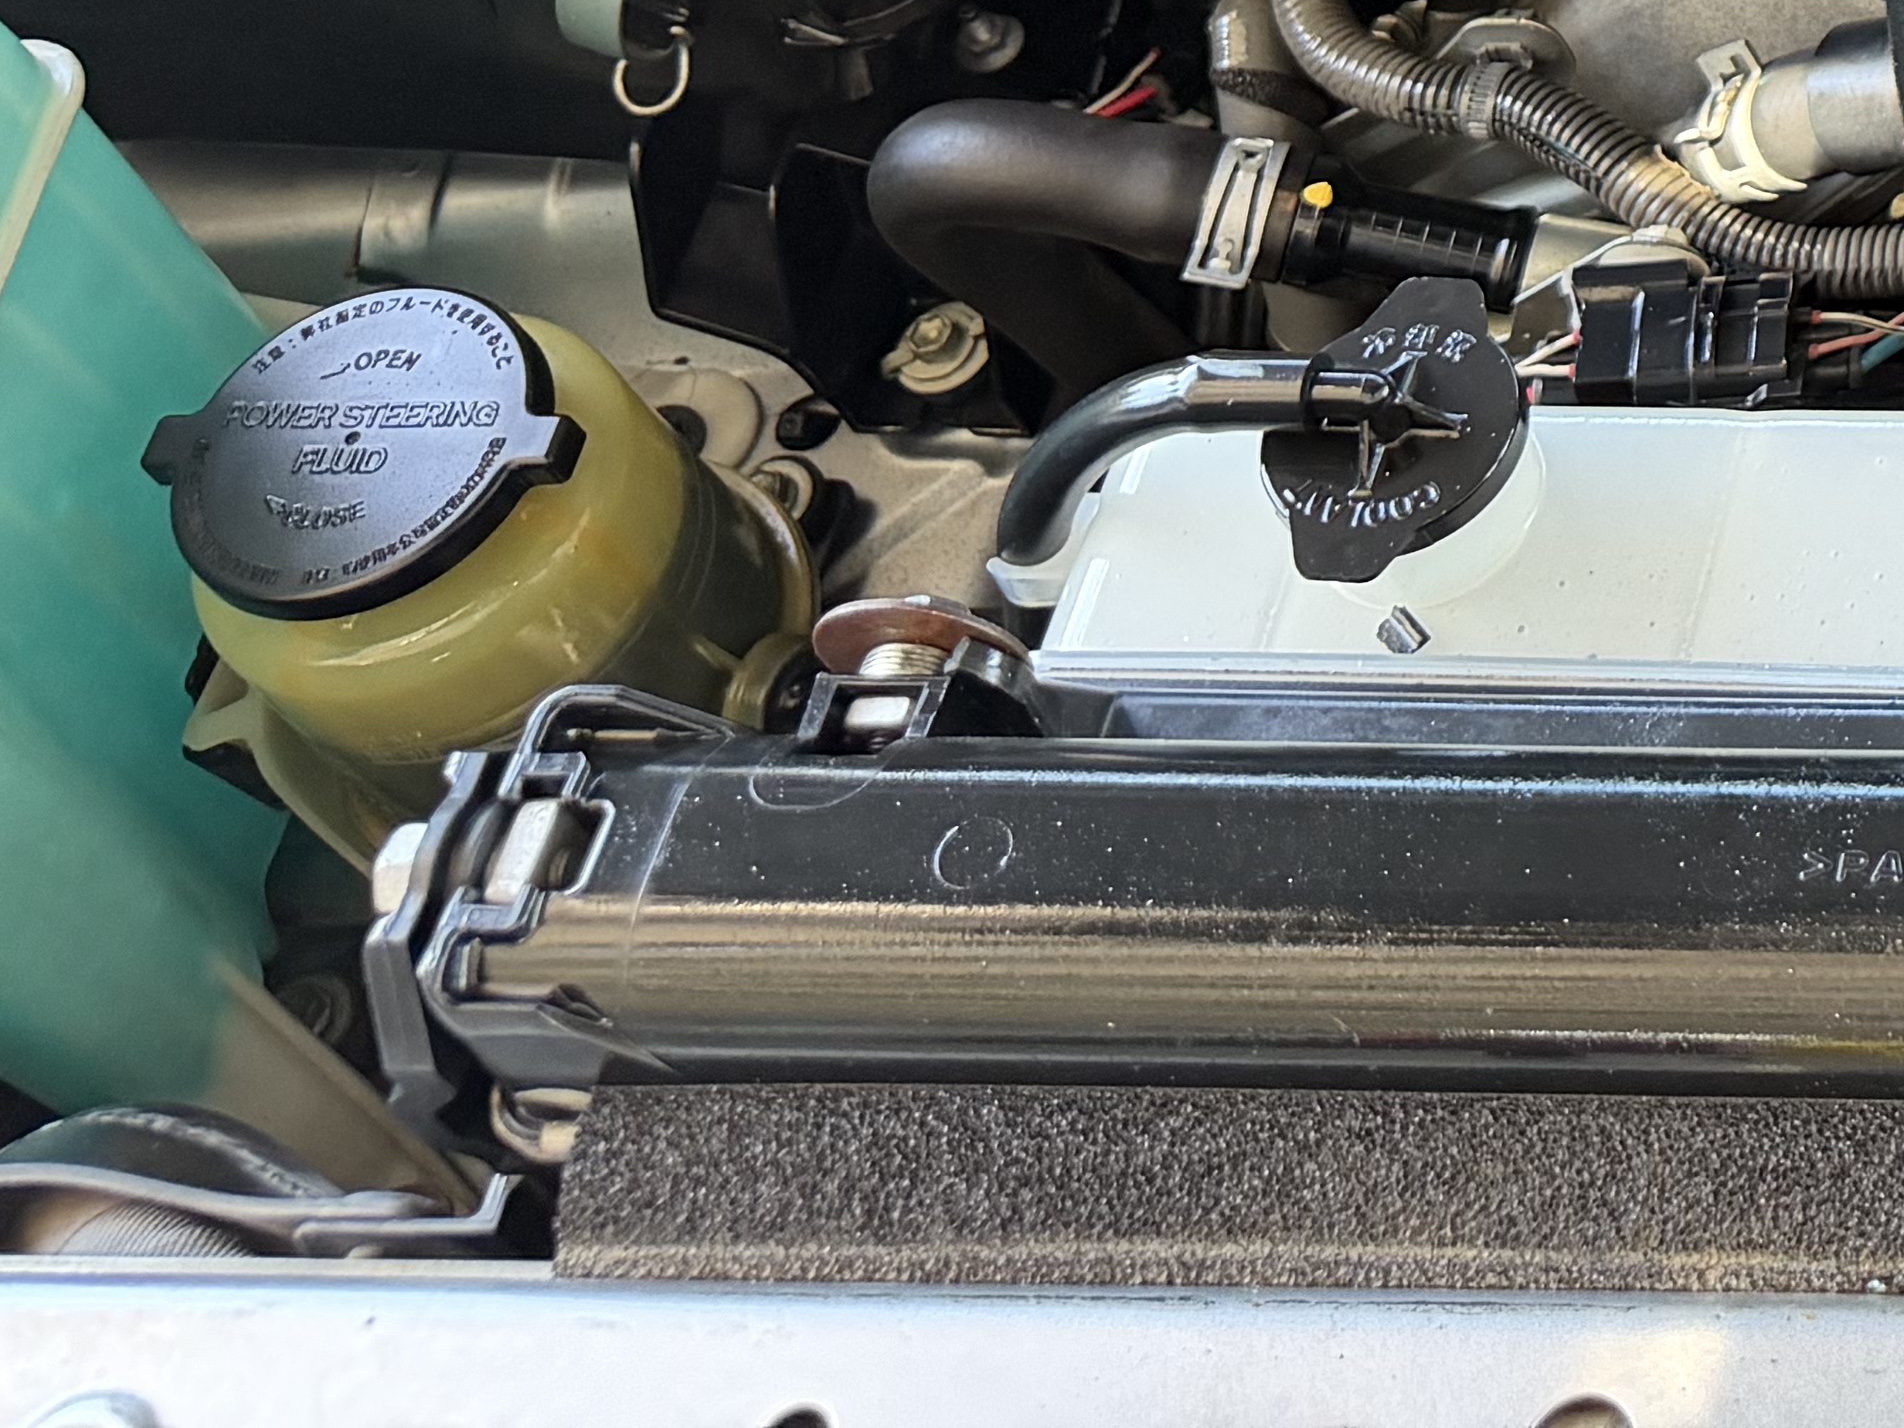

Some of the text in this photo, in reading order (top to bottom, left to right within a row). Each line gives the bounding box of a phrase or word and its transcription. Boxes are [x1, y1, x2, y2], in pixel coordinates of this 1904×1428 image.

[353, 348, 423, 373] OPEN
[223, 400, 501, 429] POWER STEERING
[290, 444, 389, 475] FLUID
